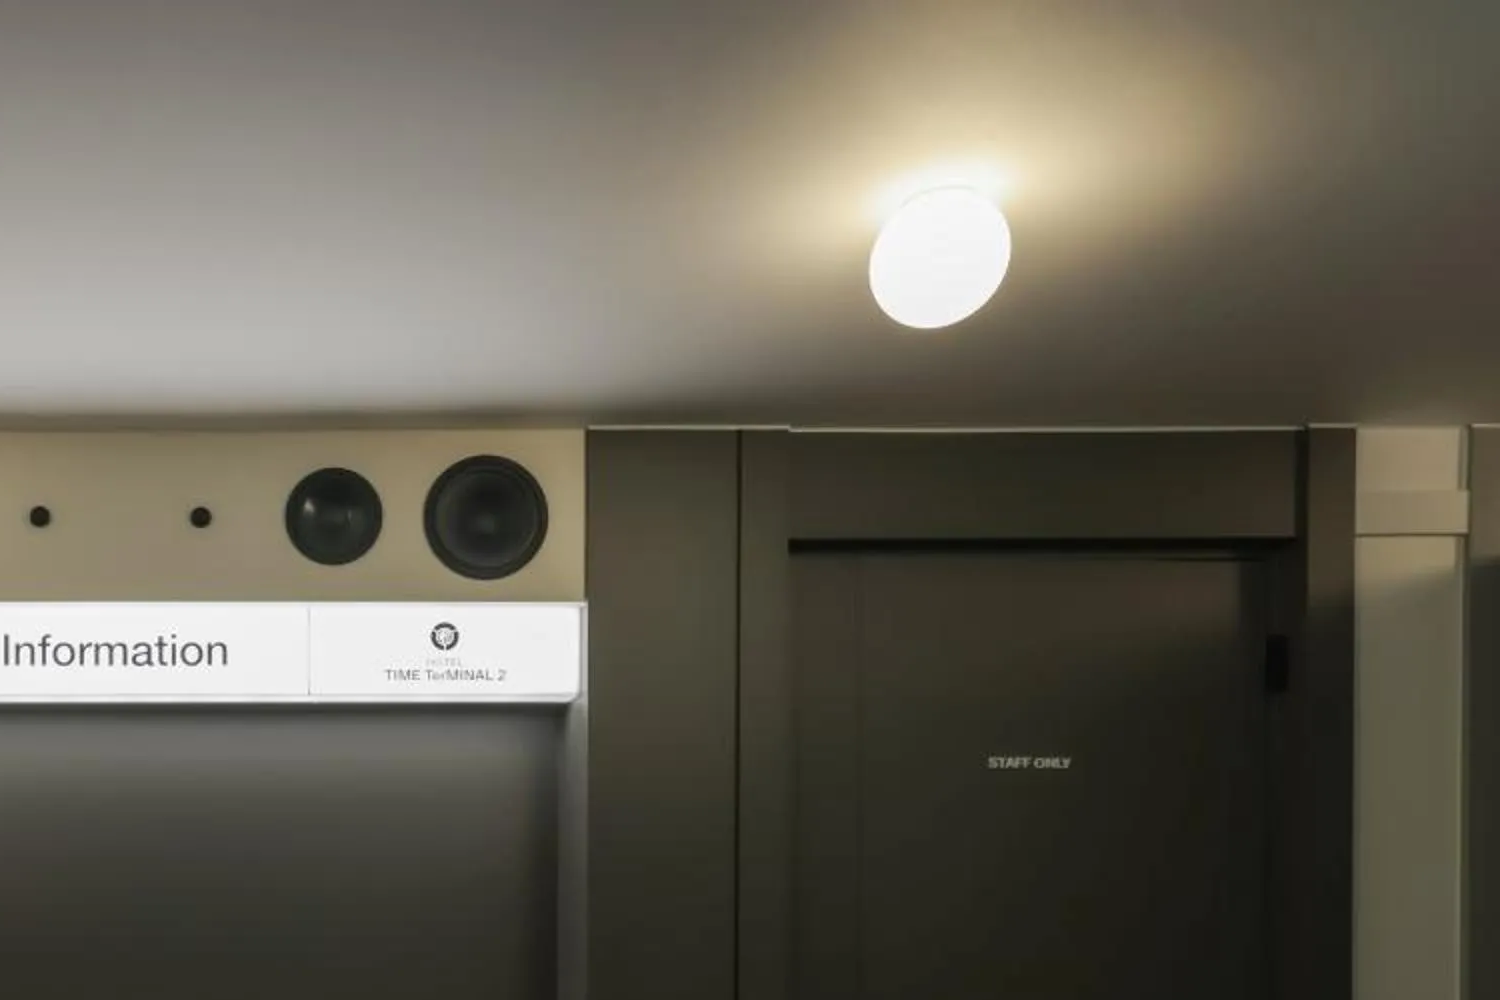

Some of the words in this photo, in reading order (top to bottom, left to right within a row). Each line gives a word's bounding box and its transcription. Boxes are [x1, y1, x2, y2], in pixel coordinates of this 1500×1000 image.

[3, 633, 228, 667] Information
[384, 668, 421, 681] TIME
[497, 668, 508, 681] 2
[988, 756, 1032, 769] STAFF
[1033, 756, 1071, 769] ONLY
